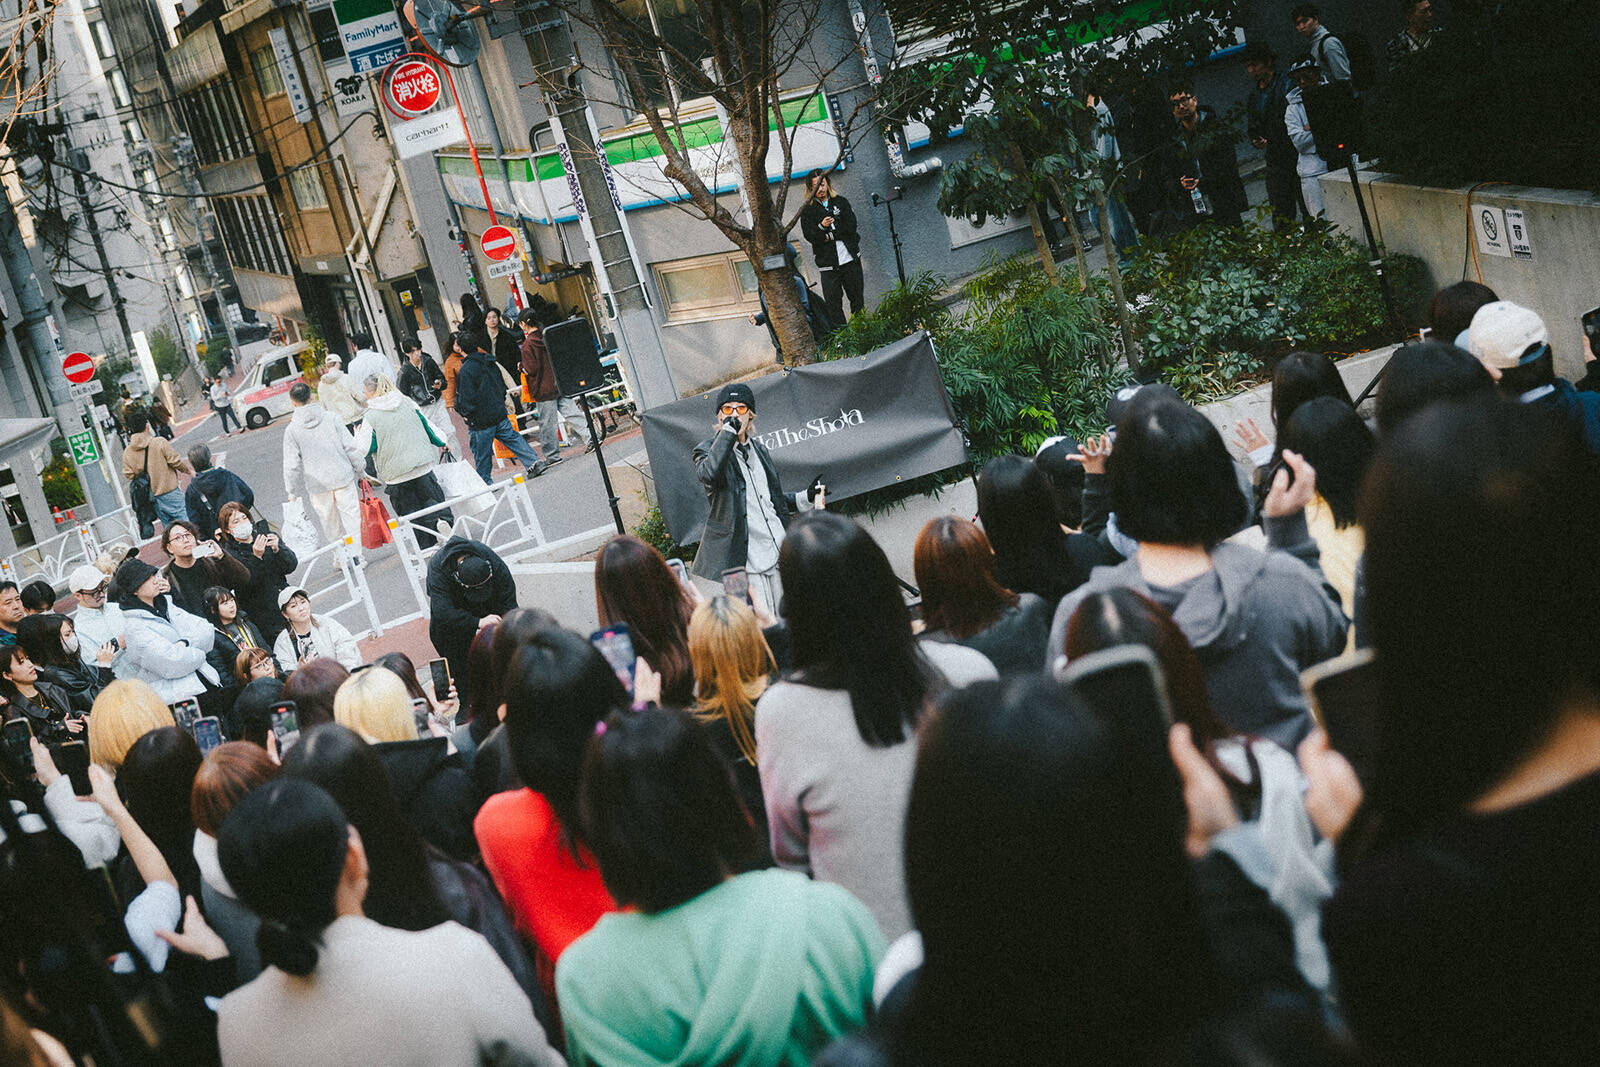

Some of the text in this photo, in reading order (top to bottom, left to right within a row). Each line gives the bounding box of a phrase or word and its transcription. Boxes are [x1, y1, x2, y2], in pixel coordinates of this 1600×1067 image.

[345, 20, 398, 43] FamilyMart
[357, 55, 372, 72] 酒
[394, 73, 437, 102] 消火栓
[341, 94, 366, 106] KOARA
